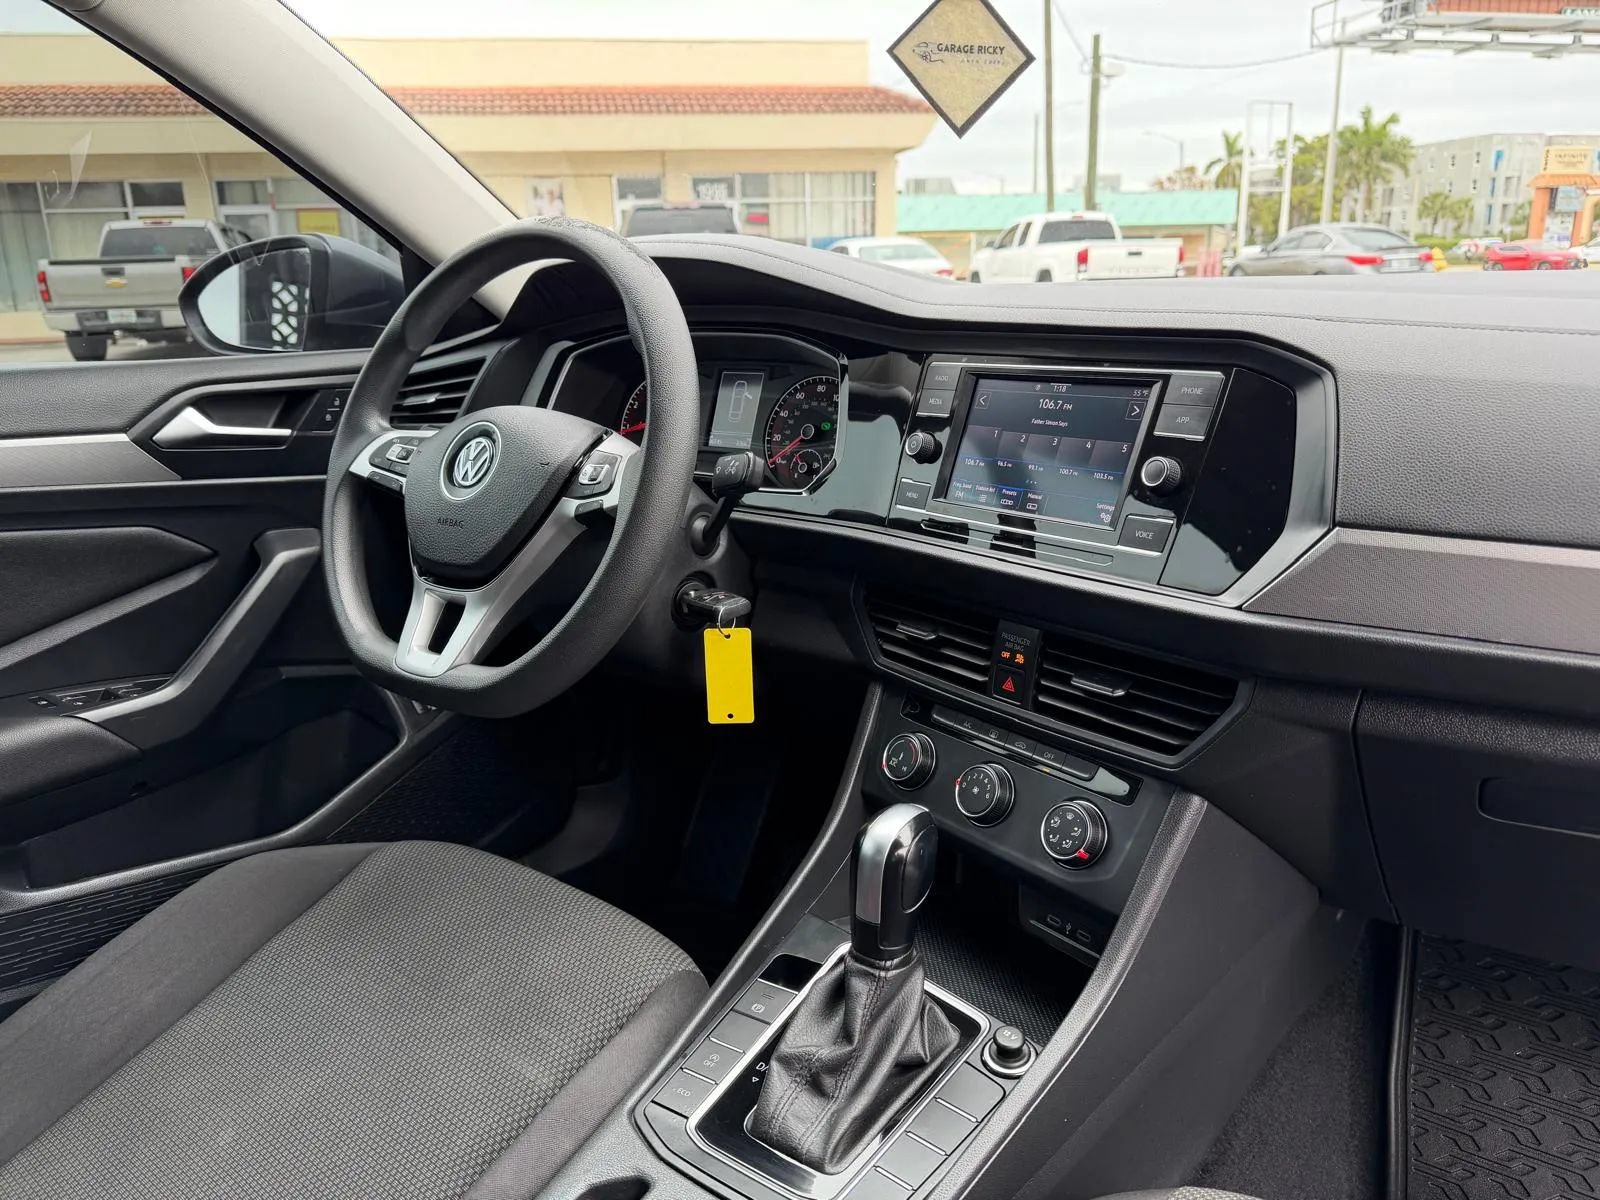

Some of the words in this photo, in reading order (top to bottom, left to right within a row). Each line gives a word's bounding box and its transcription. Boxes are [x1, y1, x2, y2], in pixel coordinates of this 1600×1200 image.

[937, 43, 975, 54] GARAGE
[977, 45, 1005, 55] RICKY
[816, 384, 826, 393] 80
[1039, 398, 1062, 410] 106.7
[994, 430, 998, 438] 1
[1020, 434, 1026, 442] 2
[1052, 438, 1058, 446] 3
[1086, 440, 1091, 448] 4
[1122, 444, 1128, 452] 5
[437, 518, 464, 529] AIRBAG
[1135, 530, 1154, 539] VOICE
[1001, 632, 1030, 646] PASSENGER
[1043, 752, 1055, 760] OFF
[756, 1062, 769, 1072] D/
[676, 1088, 691, 1096] ECO
